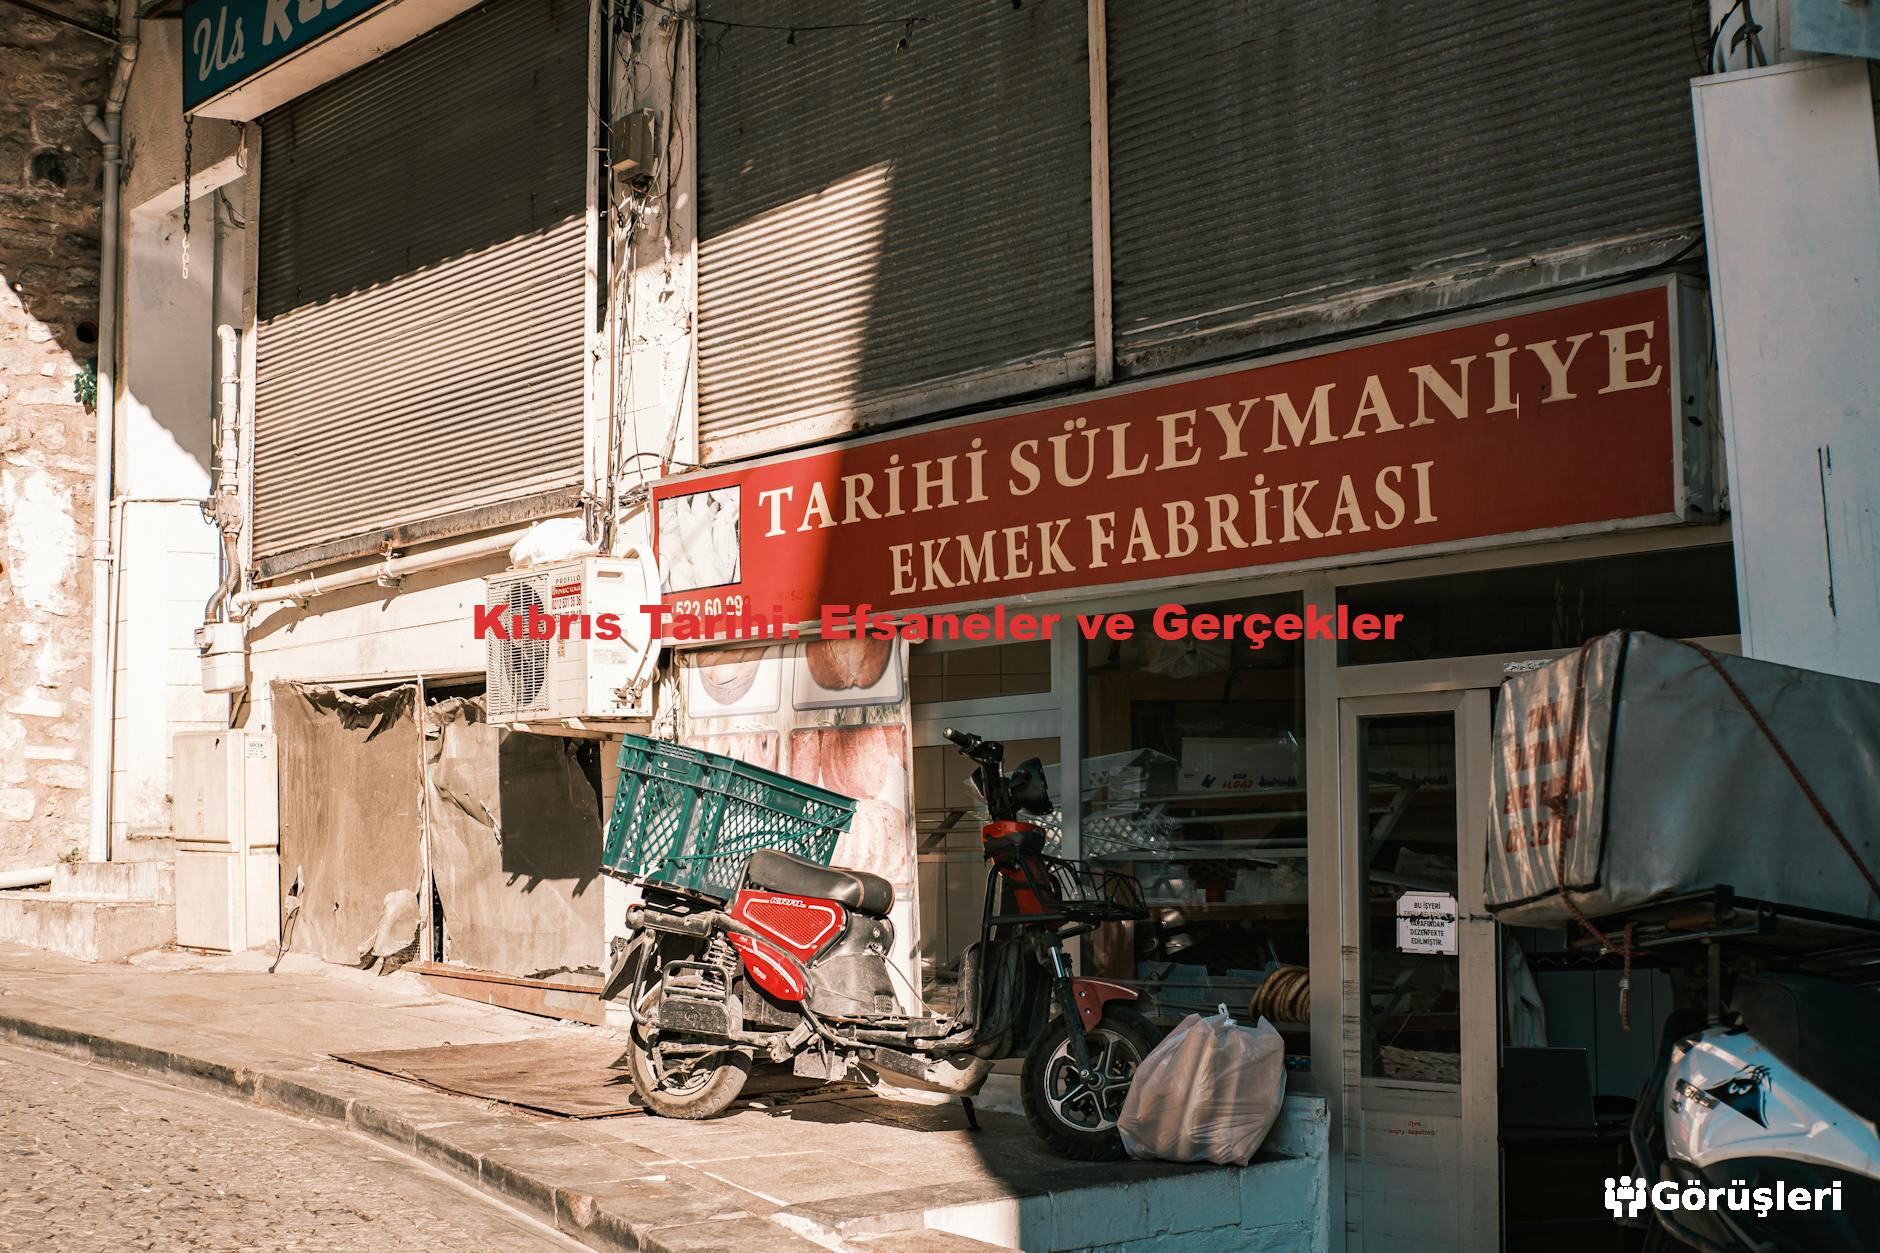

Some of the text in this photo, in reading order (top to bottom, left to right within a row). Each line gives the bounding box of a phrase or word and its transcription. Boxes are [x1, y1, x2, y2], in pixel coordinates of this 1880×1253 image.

[193, 5, 245, 82] Us
[758, 320, 1664, 538] TARİHİ SÜLEYMANİYE
[888, 460, 1439, 596] EKMEK FABRİKASI
[1410, 928, 1444, 936] DEZENFEKTE
[1423, 901, 1441, 910] İŞYERİ
